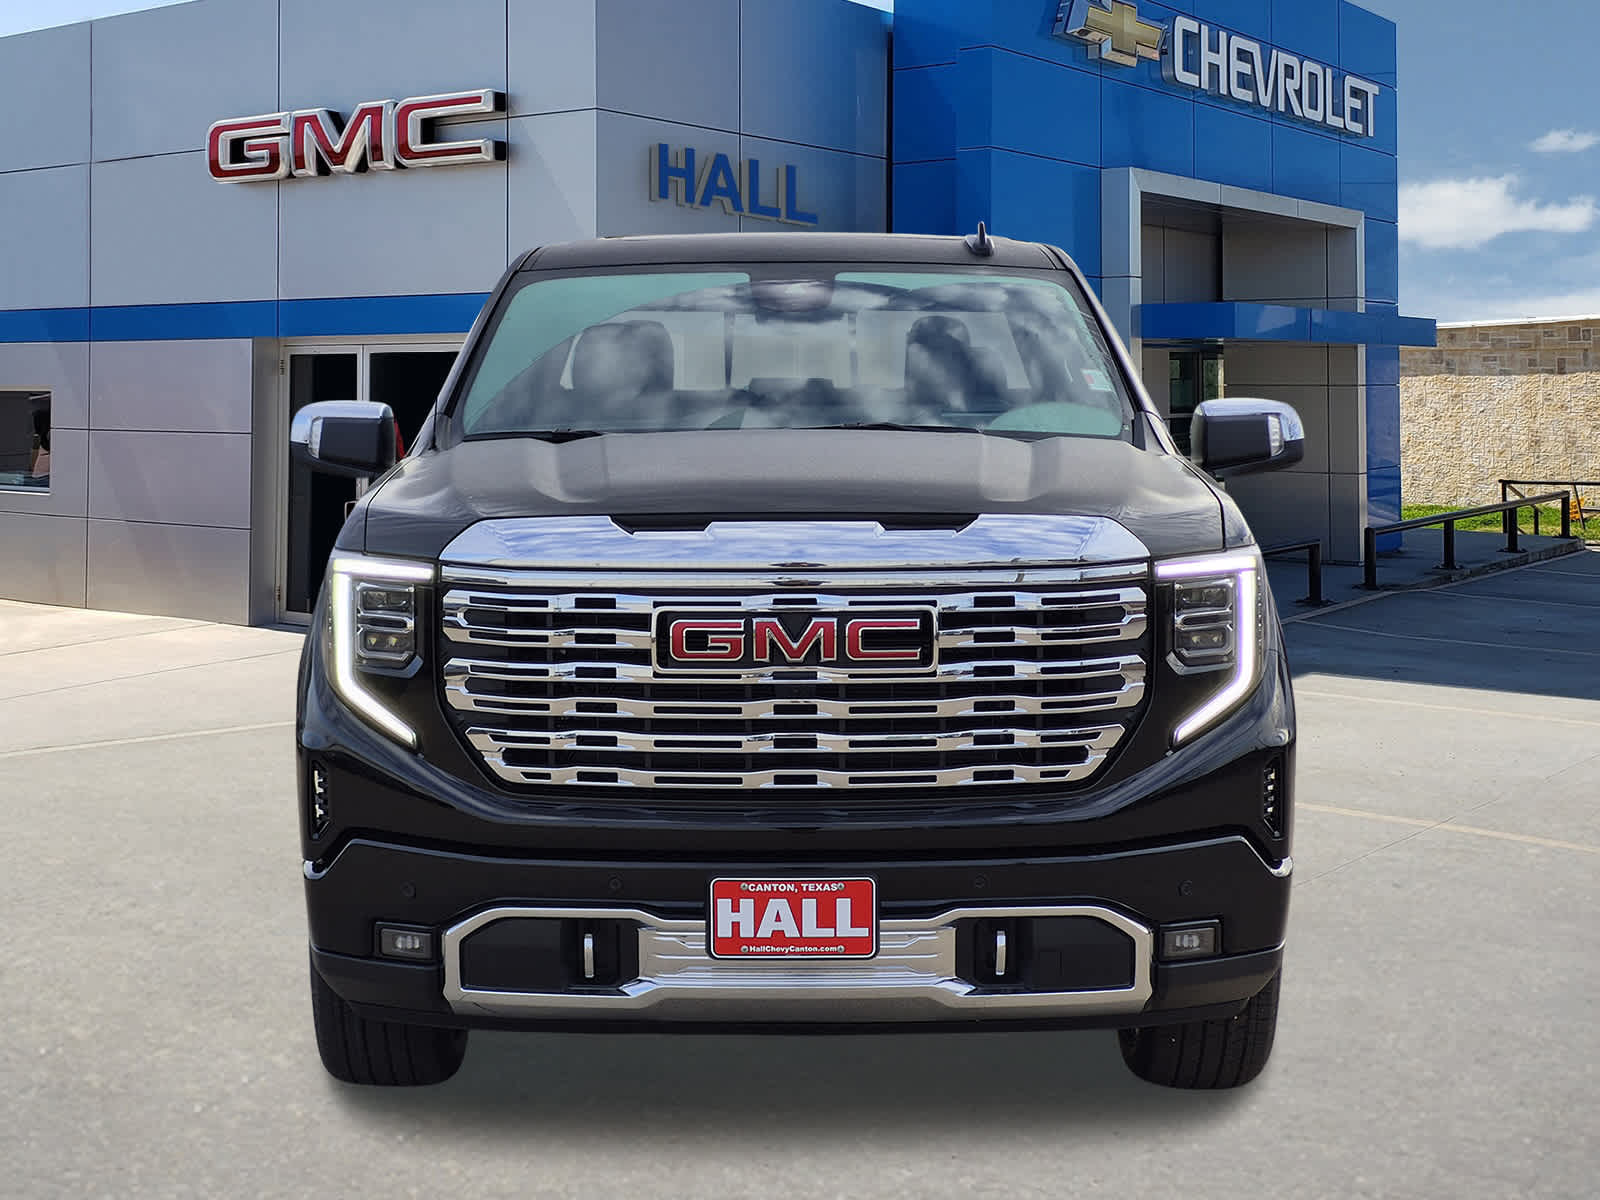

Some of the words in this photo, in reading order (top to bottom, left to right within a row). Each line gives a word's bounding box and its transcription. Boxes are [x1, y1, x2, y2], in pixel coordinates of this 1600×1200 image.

[1173, 15, 1379, 137] CHEVROLET
[206, 88, 498, 184] GMC
[657, 143, 818, 225] HALL
[670, 617, 922, 662] GMC
[749, 883, 798, 893] CANTON,
[801, 882, 838, 892] TEXAS
[717, 898, 869, 938] HALL
[749, 945, 837, 953] HallChevyCanton.com
